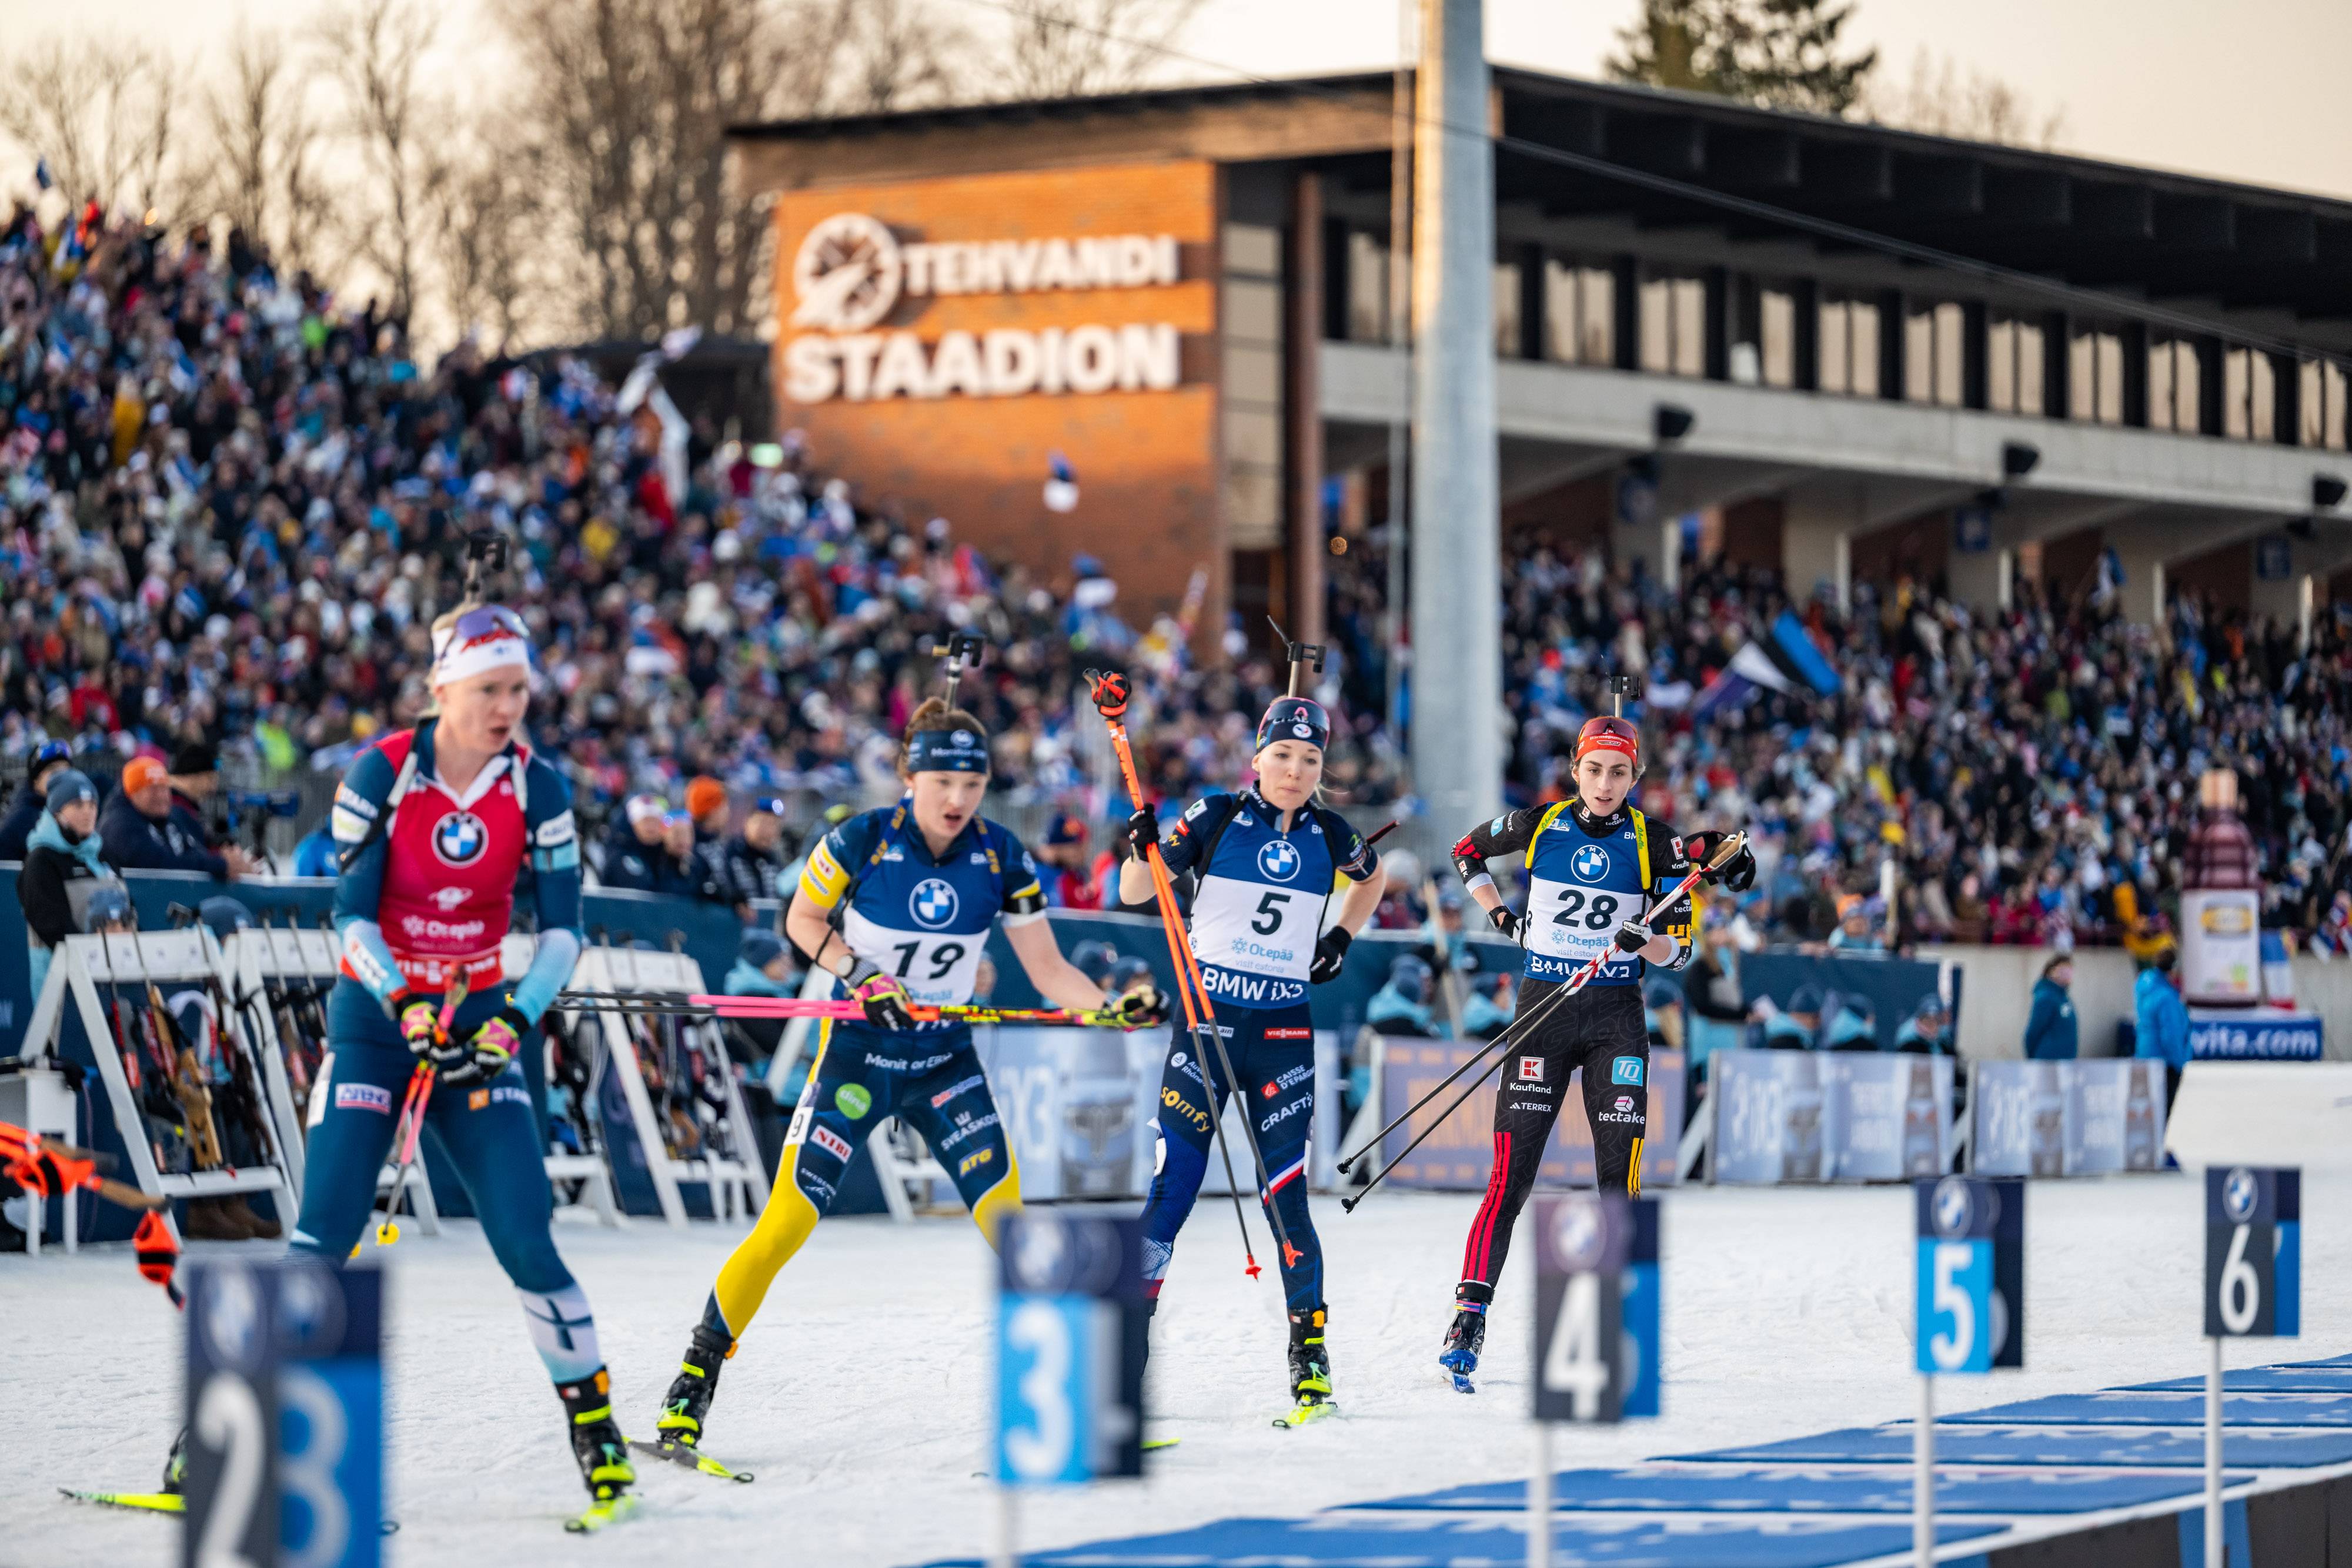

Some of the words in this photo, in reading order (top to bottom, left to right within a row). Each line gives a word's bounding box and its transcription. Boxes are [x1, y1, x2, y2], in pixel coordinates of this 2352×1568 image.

[903, 234, 1178, 295] TEHVANDI
[783, 322, 1178, 403] STAADION
[1605, 817, 1626, 826] tectake
[1623, 831, 1637, 840] BM
[1251, 891, 1292, 935] 5
[1552, 889, 1619, 931] 28
[1249, 943, 1294, 961] Otepää
[1566, 934, 1609, 949] Otepää
[1573, 949, 1599, 958] estoni
[893, 940, 965, 980] 19
[1235, 959, 1253, 968] visit
[1254, 962, 1285, 974] estonia
[1201, 967, 1268, 1001] BMW
[1267, 1028, 1309, 1038] VIESSMANN
[1276, 1064, 1306, 1084] CAISSE
[1279, 1065, 1315, 1090] D'EPARGN
[1618, 1059, 1640, 1082] TQ
[1509, 1082, 1552, 1094] Kaufland
[1160, 1086, 1211, 1132] somfy
[1261, 1095, 1308, 1132] CRAFT
[1521, 1102, 1552, 1112] TERREX
[1598, 1111, 1645, 1124] tectake
[960, 1148, 993, 1177] ATG
[2219, 1223, 2260, 1334] 6
[1929, 1242, 1976, 1370] 5
[1542, 1268, 1611, 1420] 4
[1004, 1296, 1074, 1479] 3
[196, 1369, 266, 1568] 2
